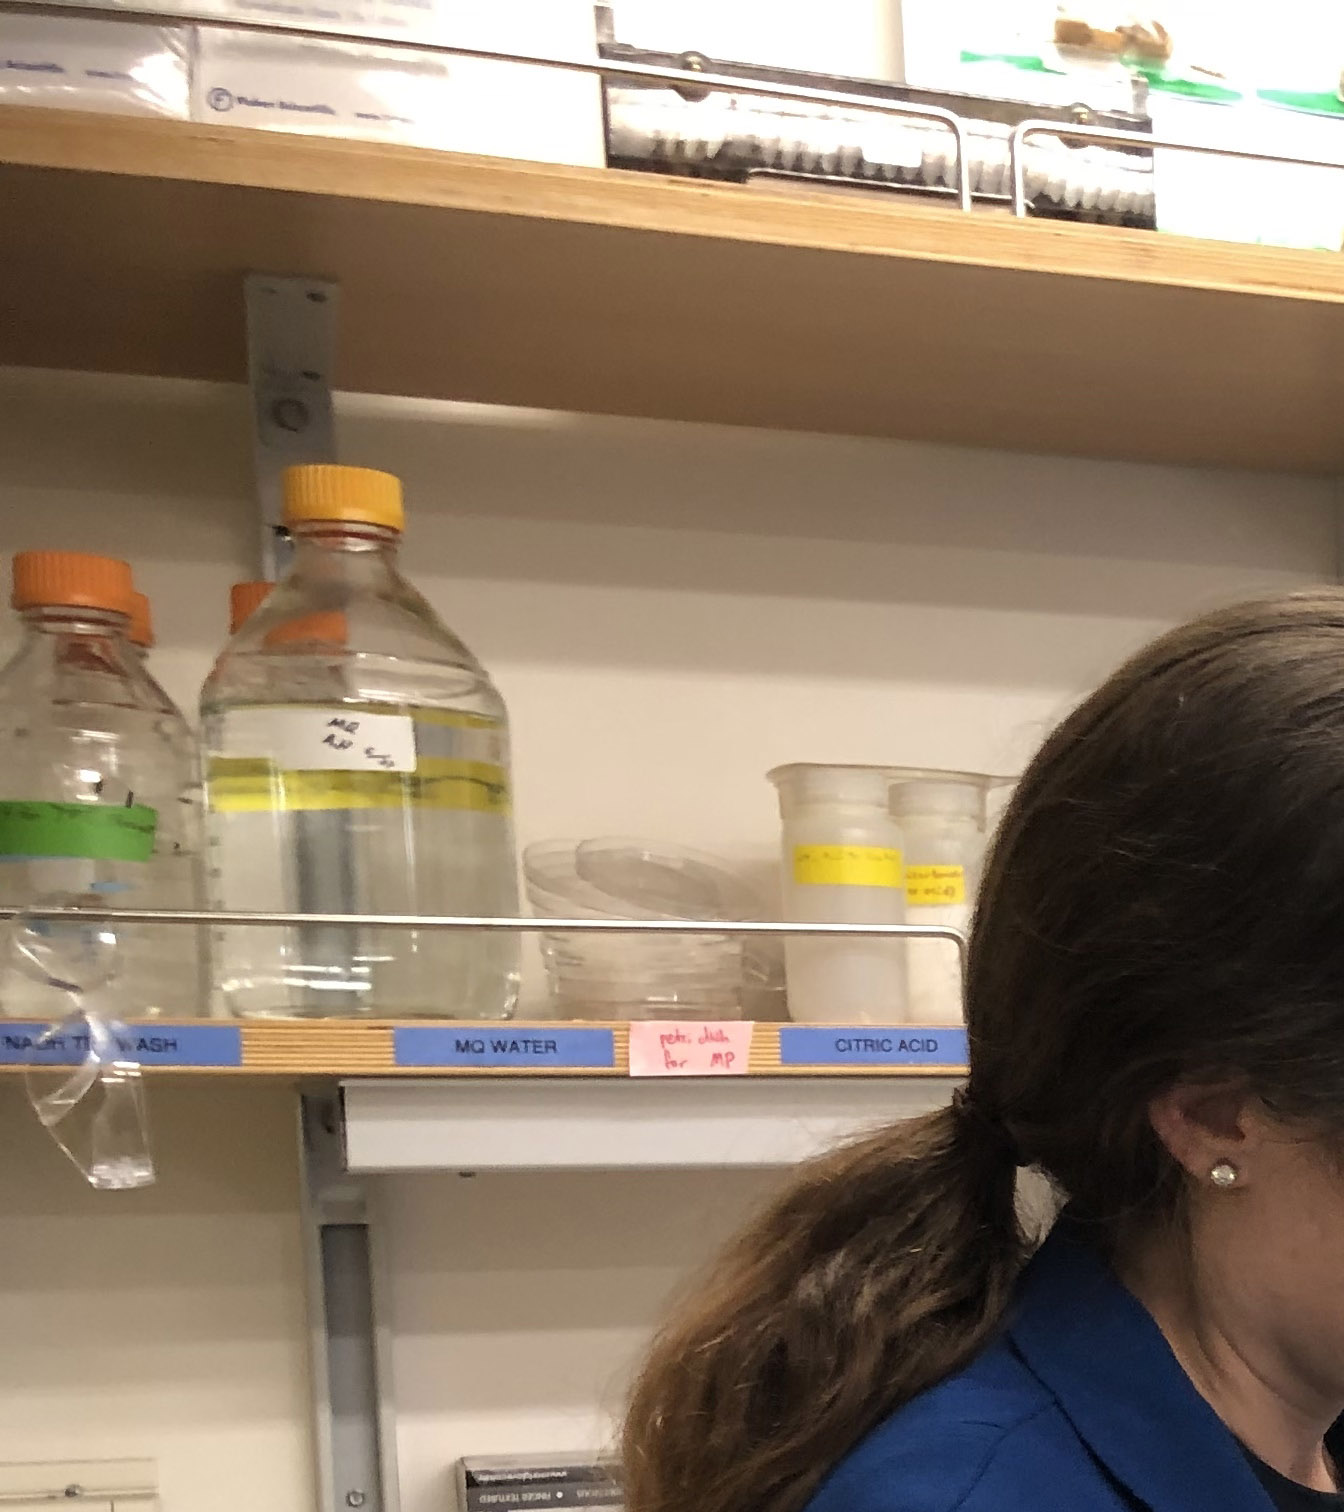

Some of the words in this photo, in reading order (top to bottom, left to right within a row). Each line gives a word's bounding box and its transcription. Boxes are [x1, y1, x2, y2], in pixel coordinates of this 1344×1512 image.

[454, 1039, 485, 1055] MQ
[489, 1039, 558, 1054] WATER
[834, 1038, 892, 1053] CITRIC
[898, 1038, 938, 1053] ACID
[710, 1051, 736, 1069] MP
